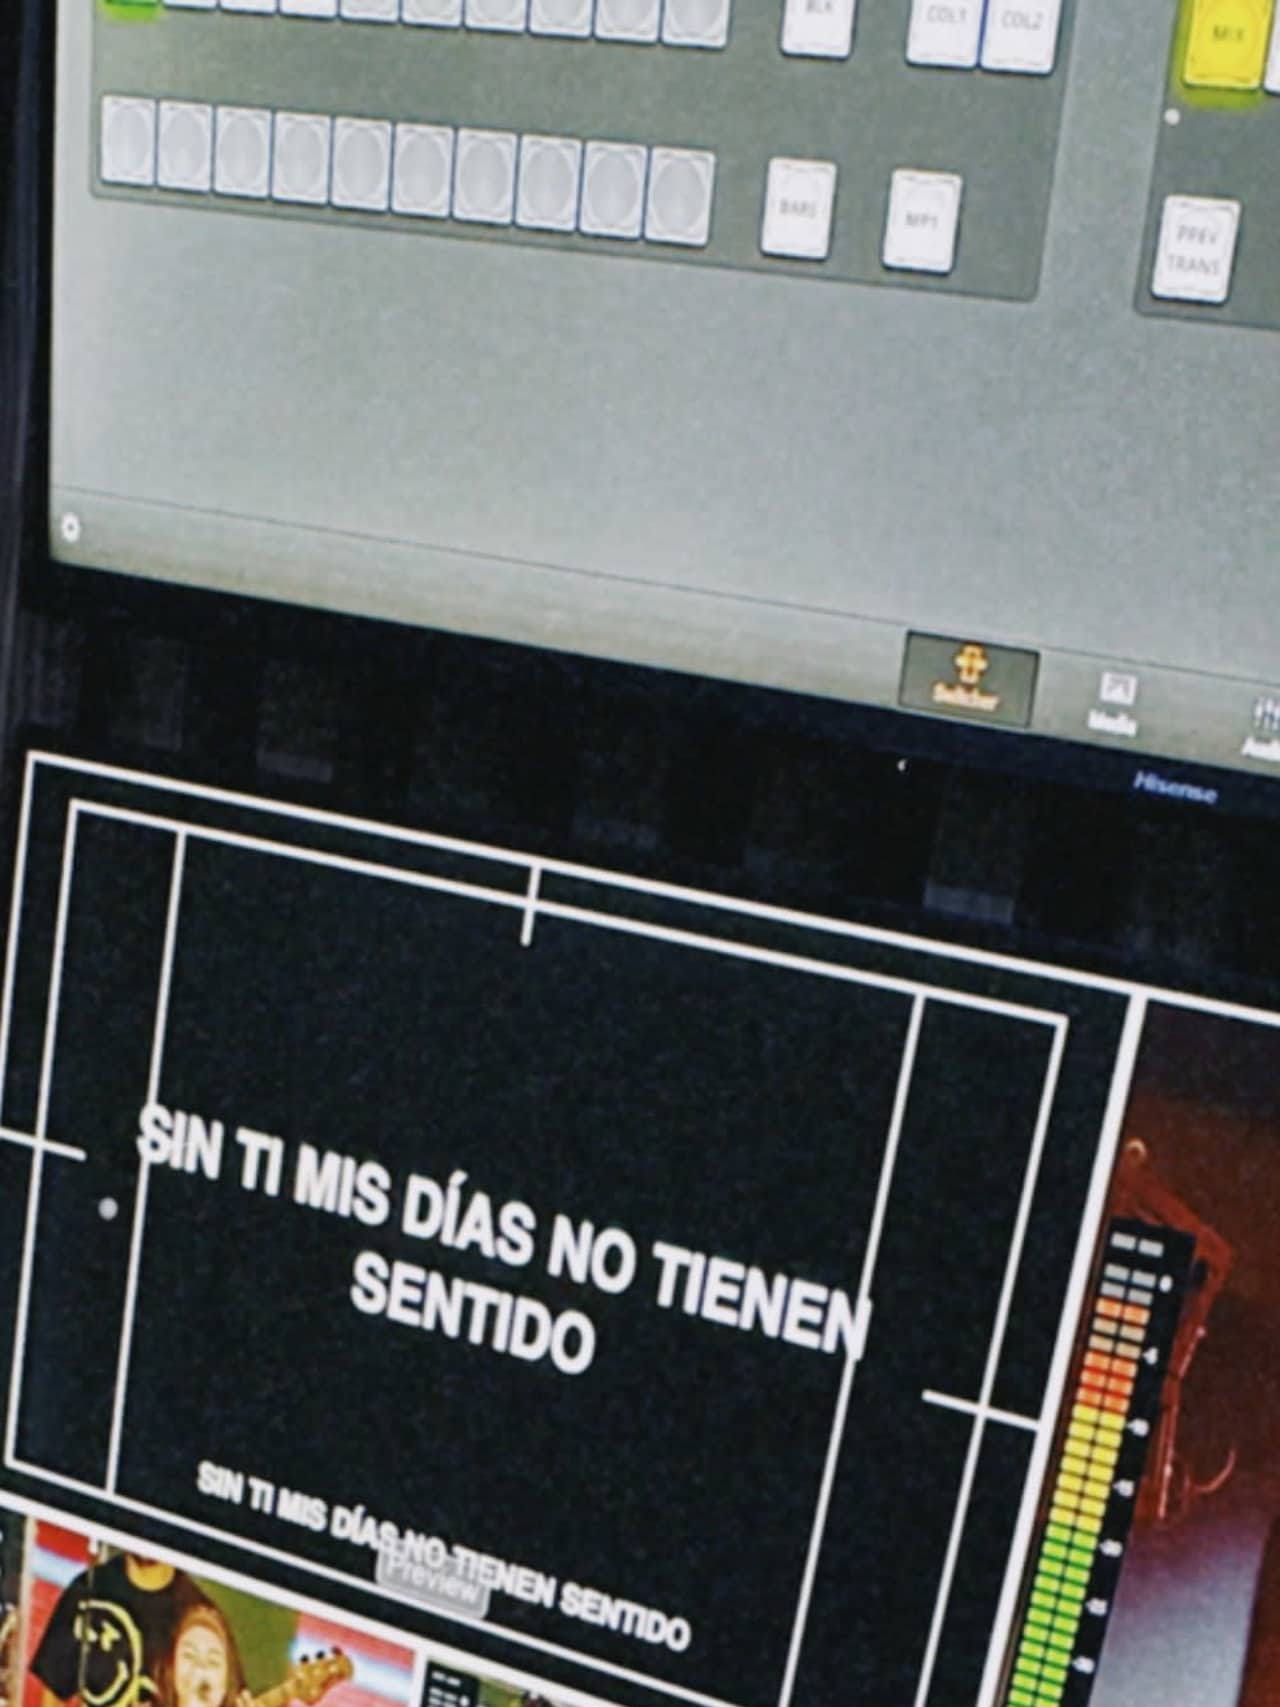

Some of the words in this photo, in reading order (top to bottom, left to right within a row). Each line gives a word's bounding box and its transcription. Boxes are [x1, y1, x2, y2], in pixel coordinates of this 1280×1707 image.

[1133, 770, 1218, 804] Hisense
[136, 1102, 222, 1180] SIN
[235, 1127, 284, 1197] TI
[294, 1144, 391, 1226] MIS
[400, 1168, 537, 1268] DÍAS
[546, 1212, 637, 1294] NO
[652, 1241, 872, 1362] TIENEN
[349, 1250, 597, 1375] SENTIDO
[196, 1460, 244, 1504] SIN
[248, 1477, 275, 1514] TI
[275, 1488, 329, 1532] MIS
[450, 1544, 556, 1609] TIENEN
[559, 1582, 692, 1652] SENTIDO
